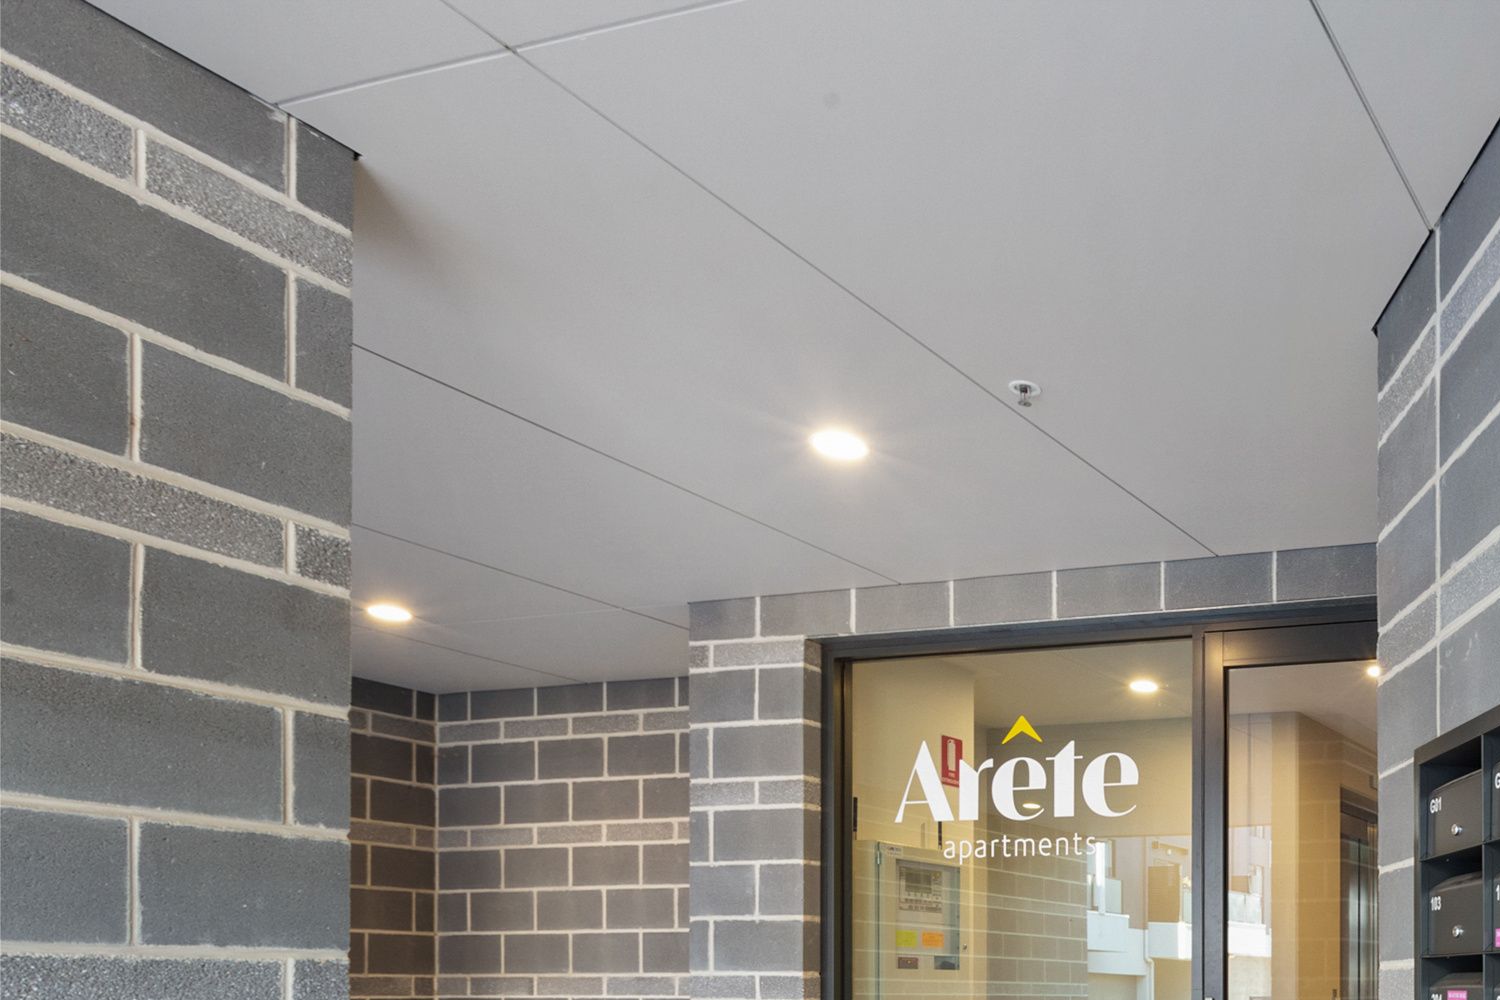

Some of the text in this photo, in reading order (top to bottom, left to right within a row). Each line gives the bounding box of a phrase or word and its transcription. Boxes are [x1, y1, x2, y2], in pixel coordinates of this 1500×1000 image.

[1429, 796, 1442, 814] G01
[943, 832, 1097, 865] apartments
[1430, 895, 1442, 911] 103
